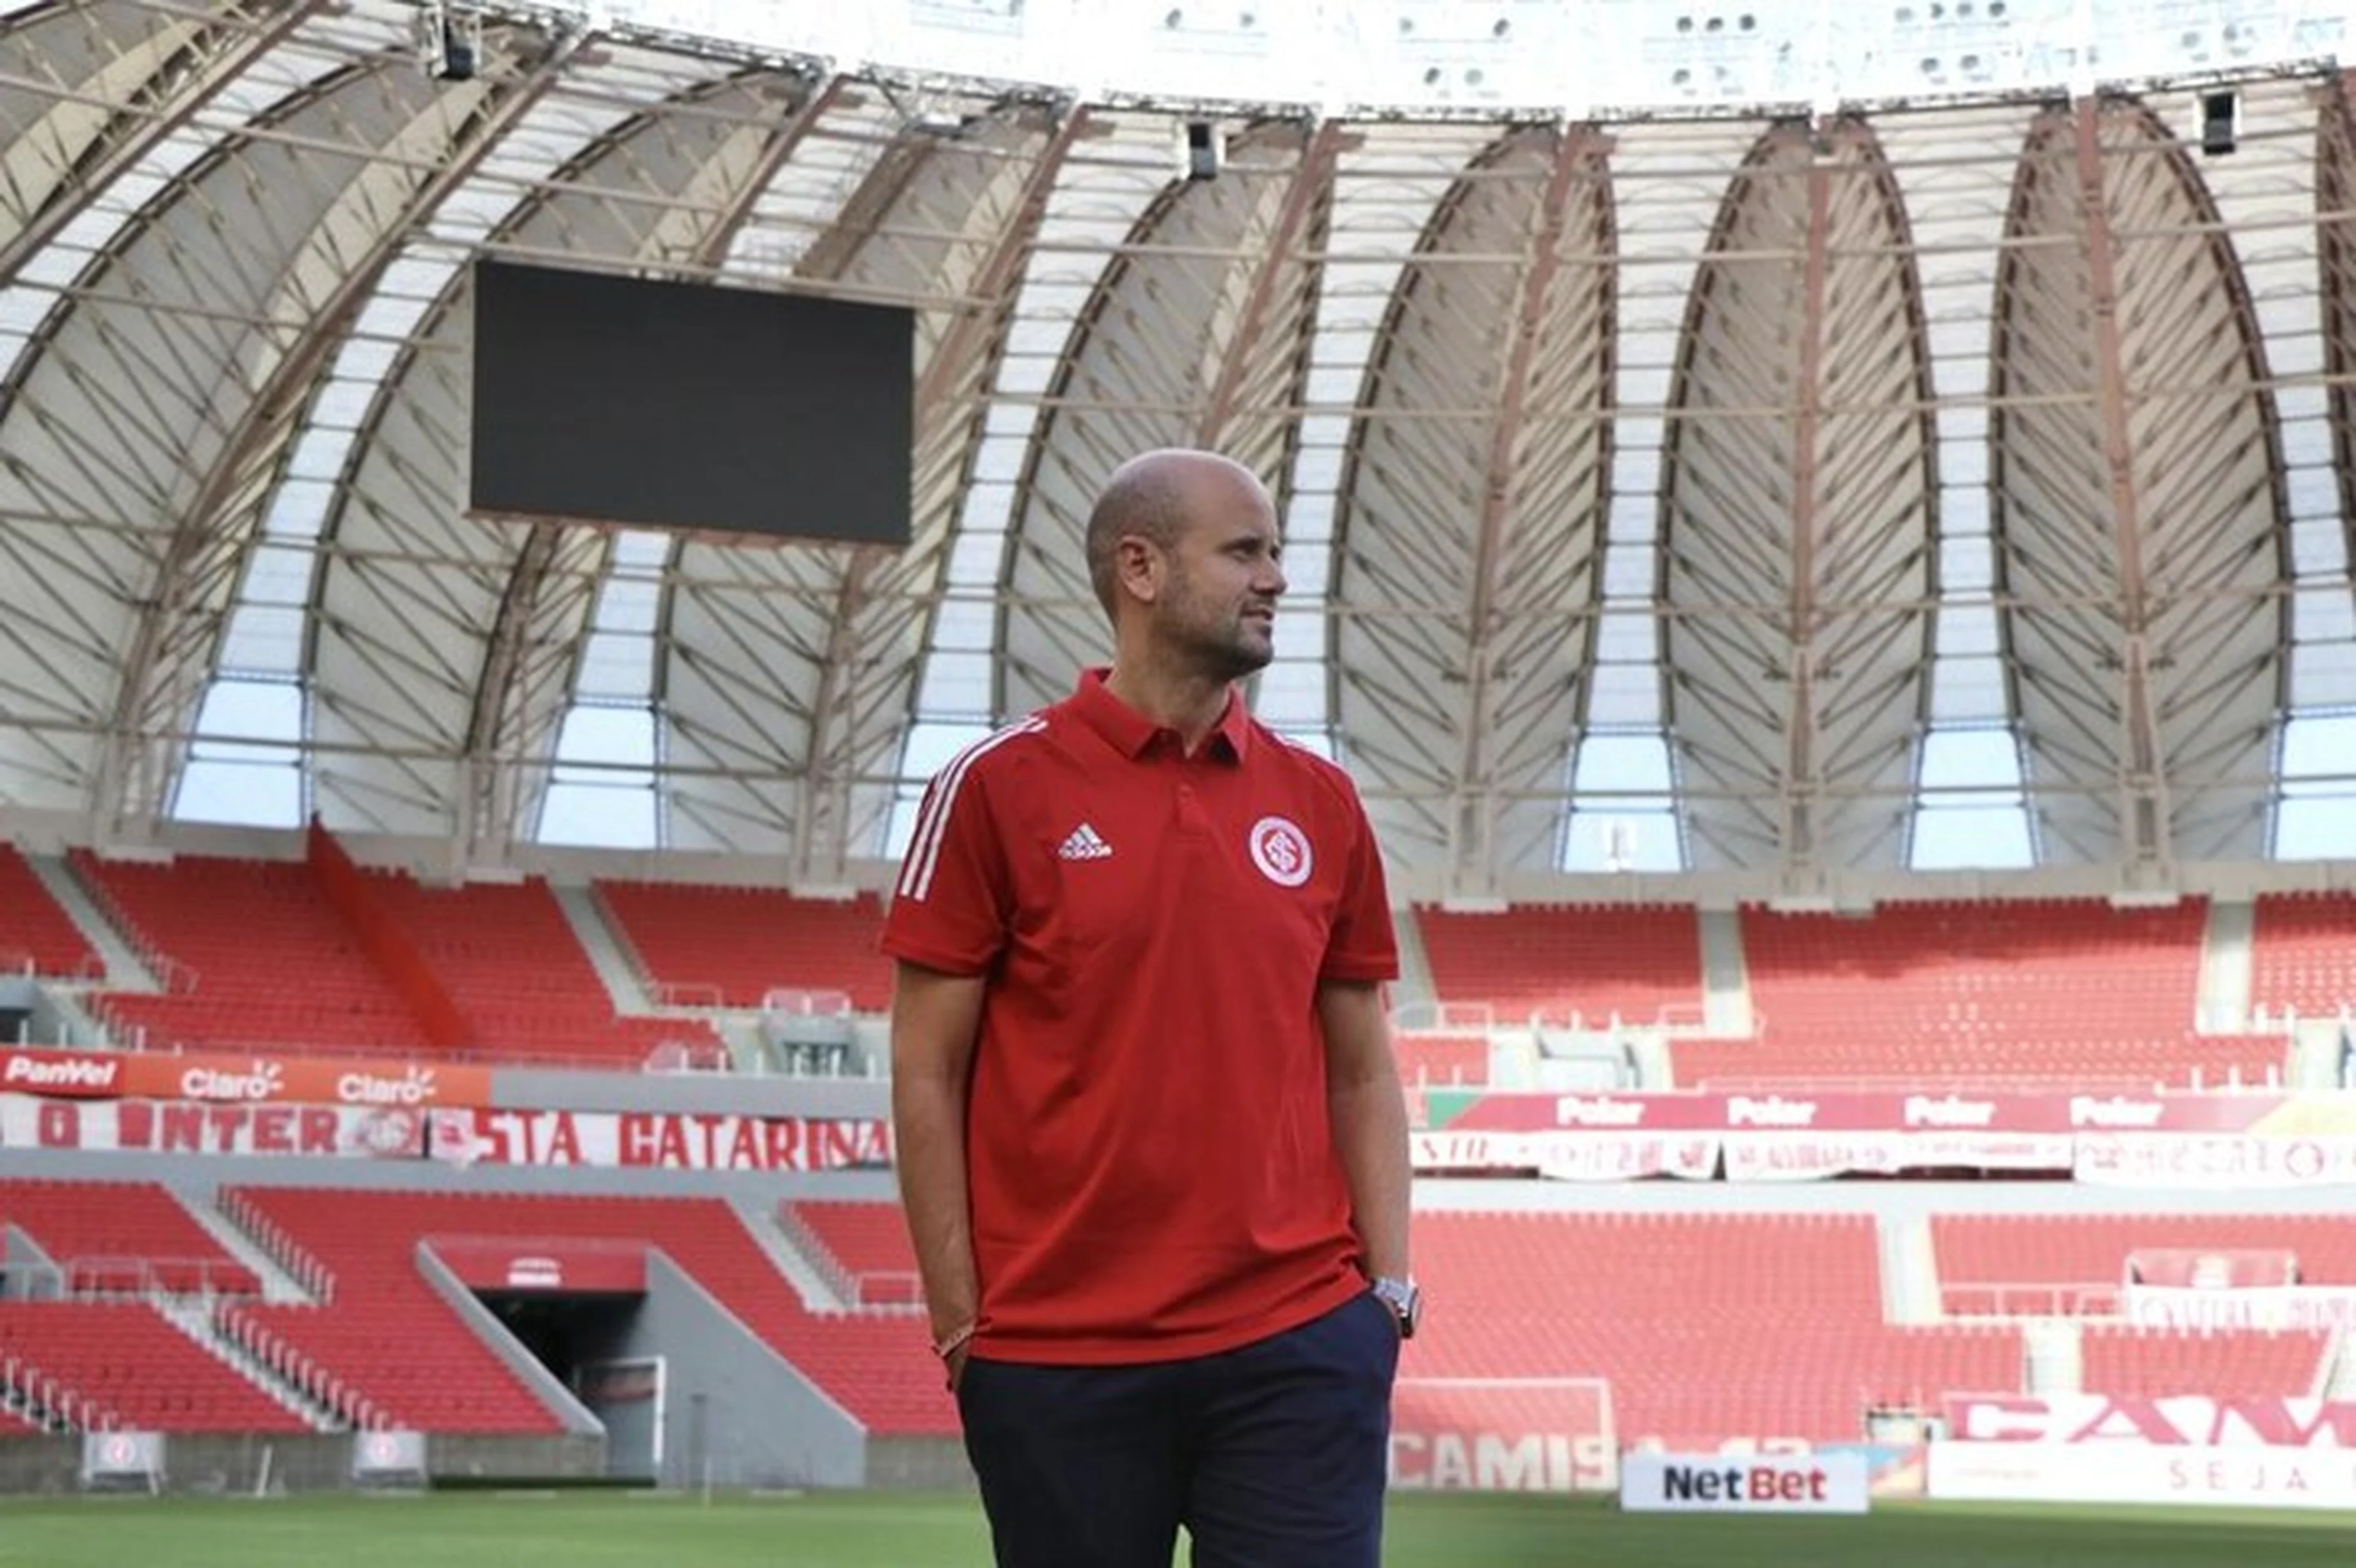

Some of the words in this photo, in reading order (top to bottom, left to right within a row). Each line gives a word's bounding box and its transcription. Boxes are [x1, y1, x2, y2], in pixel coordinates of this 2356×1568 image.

[182, 1069, 274, 1098] Claro
[337, 1074, 423, 1102] Claro
[1663, 1465, 1827, 1501] NetBet
[2169, 1461, 2308, 1490] SEJA
